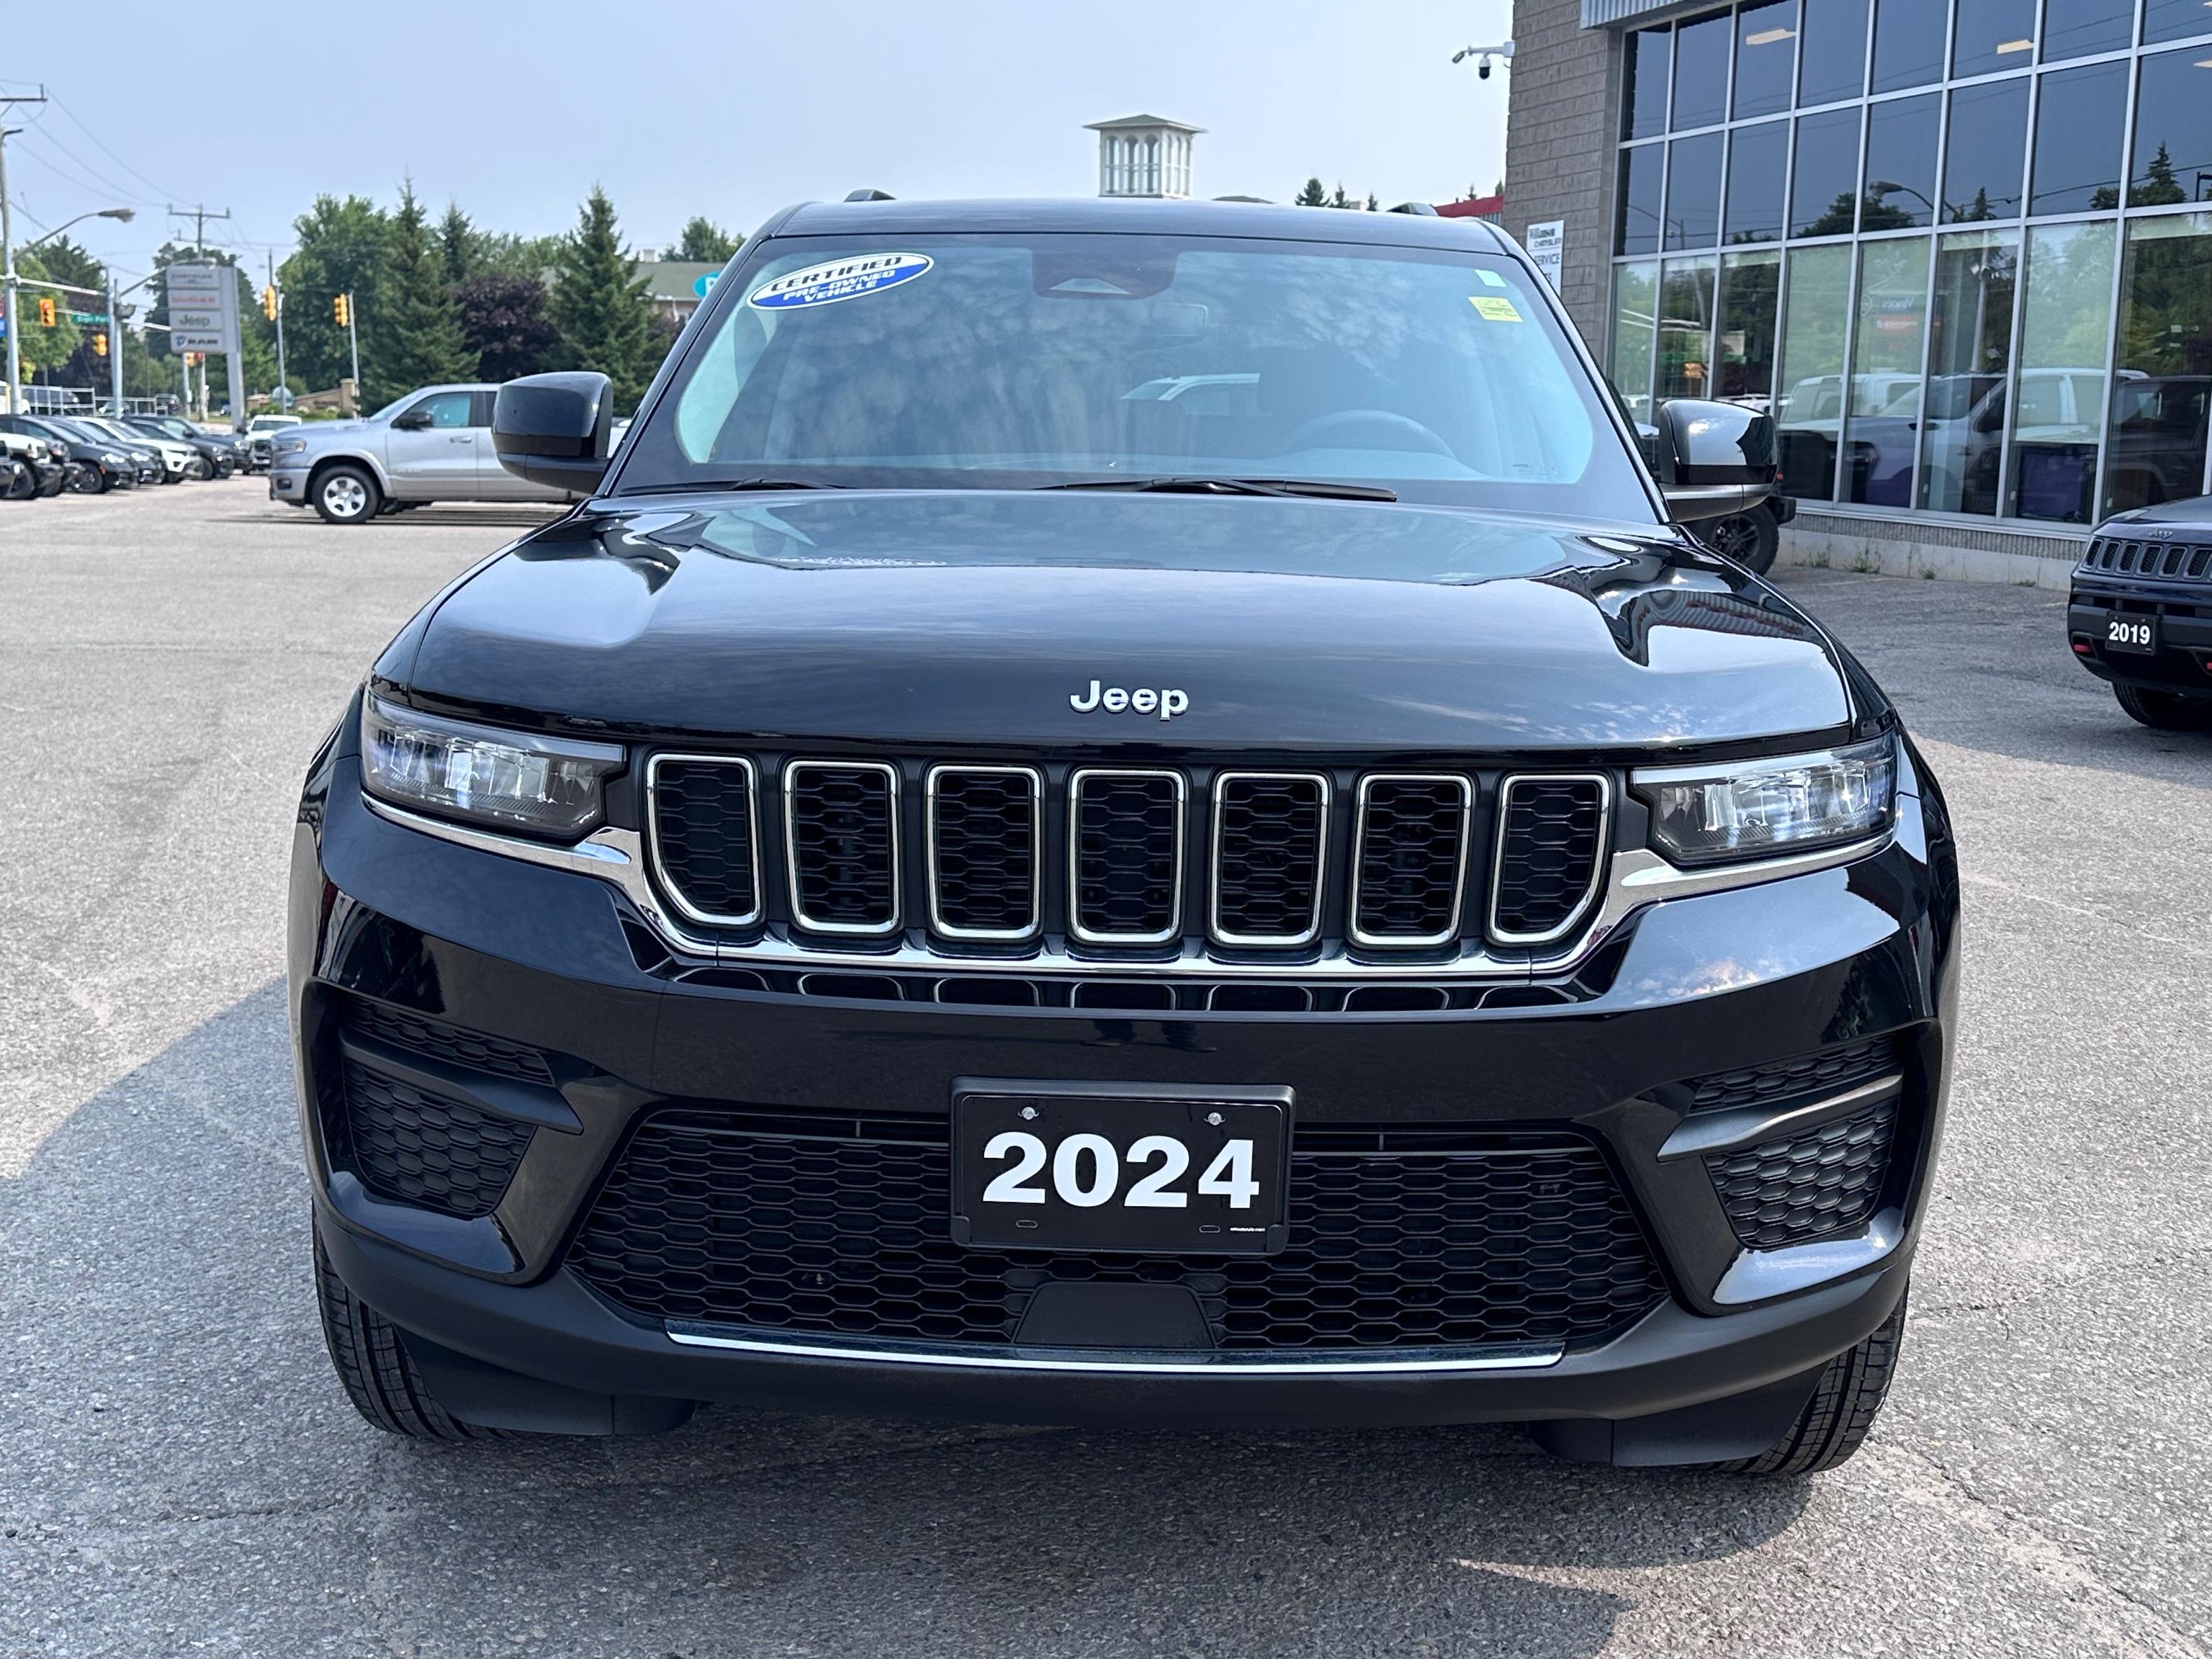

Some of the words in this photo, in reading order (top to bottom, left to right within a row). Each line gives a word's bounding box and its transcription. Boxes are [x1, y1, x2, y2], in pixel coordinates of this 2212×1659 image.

[770, 256, 902, 292] CERTIFIED
[783, 270, 896, 301] PRE-OWNED
[804, 280, 878, 302] VEHICLE
[179, 315, 210, 327] Jeep
[2108, 621, 2151, 645] 2019
[1070, 680, 1189, 721] Jeep
[982, 1131, 1260, 1209] 2024
